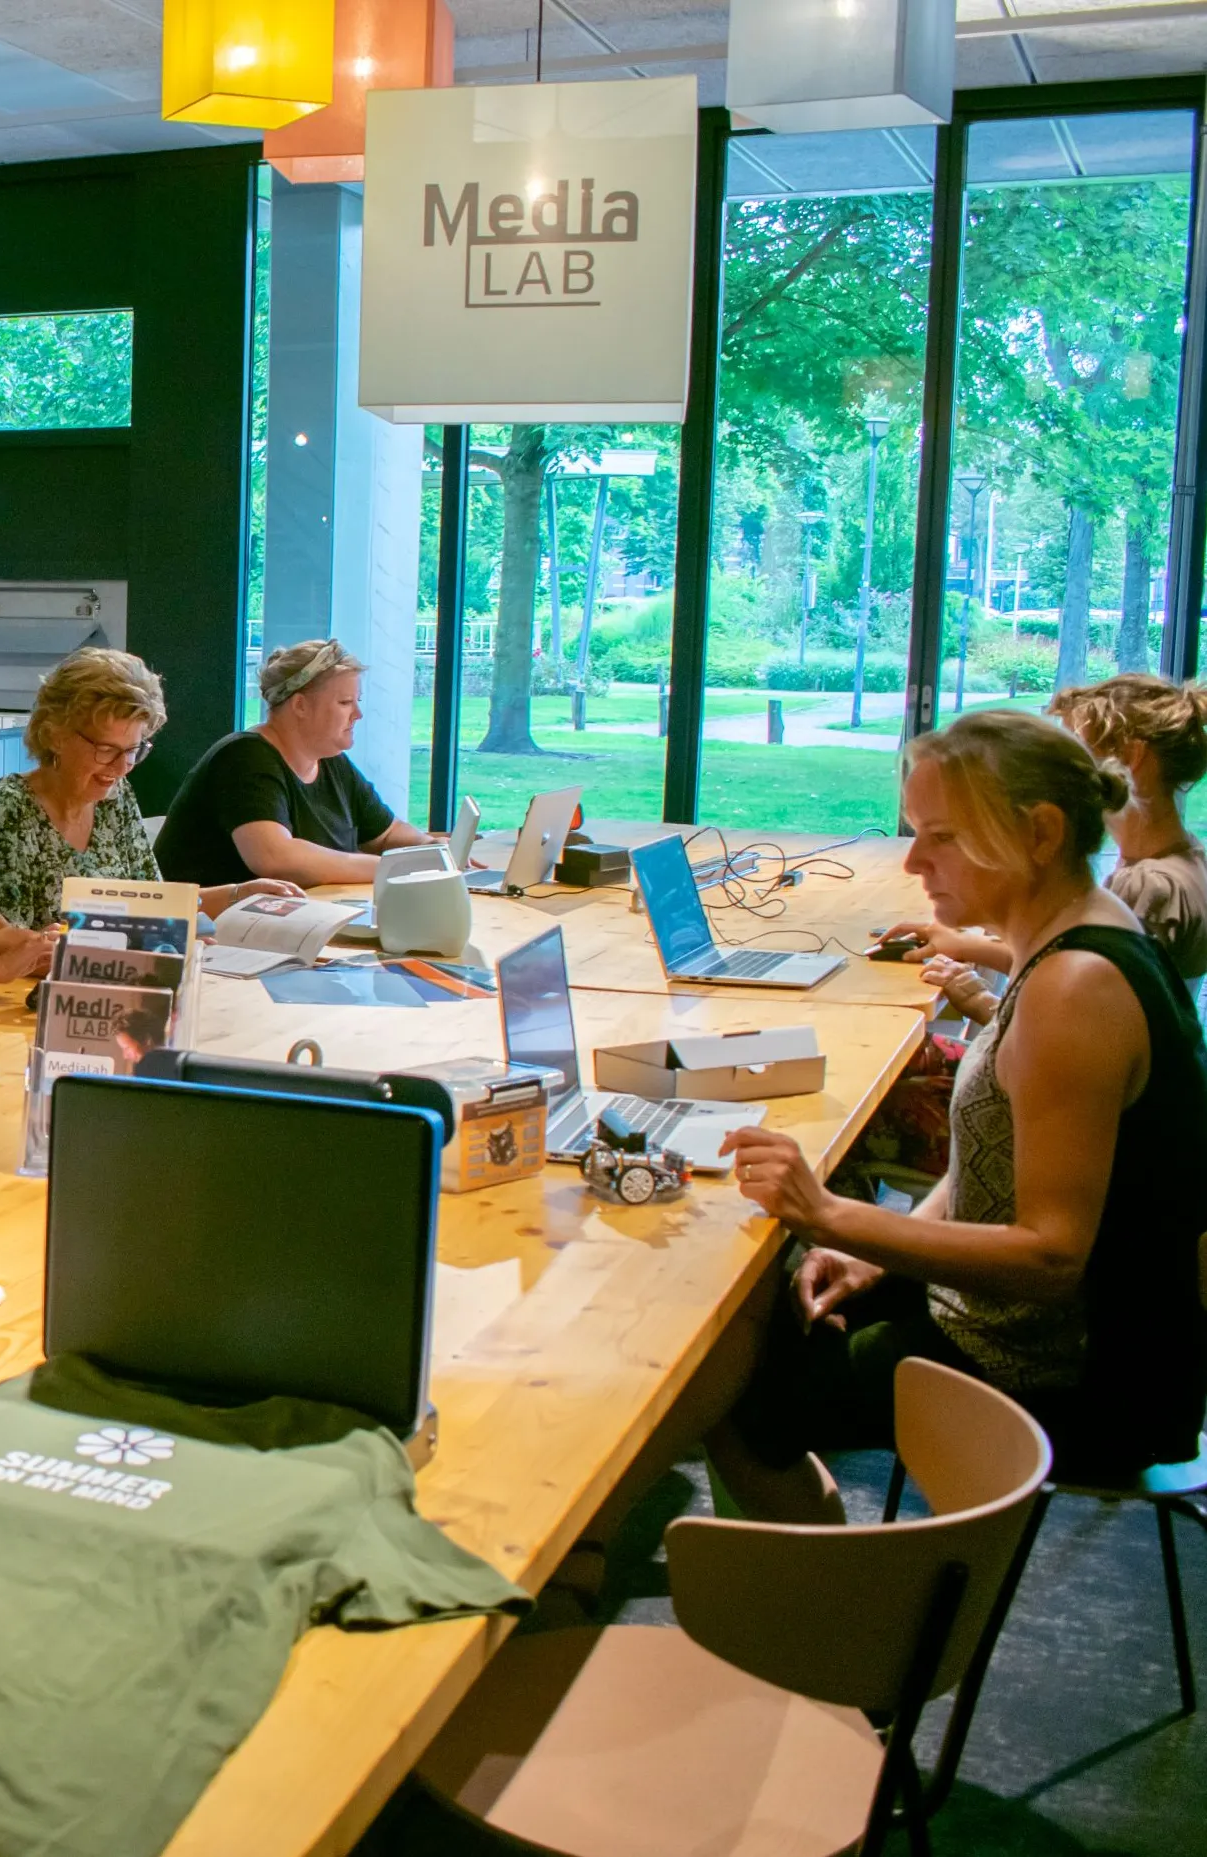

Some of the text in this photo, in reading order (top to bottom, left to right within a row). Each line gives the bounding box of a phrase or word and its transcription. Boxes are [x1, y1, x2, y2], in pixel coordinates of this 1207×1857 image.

[423, 178, 639, 247] Media
[484, 250, 595, 296] LAB
[73, 1019, 109, 1037] LAB
[23, 1473, 75, 1492] MY
[70, 1483, 153, 1510] MIND
